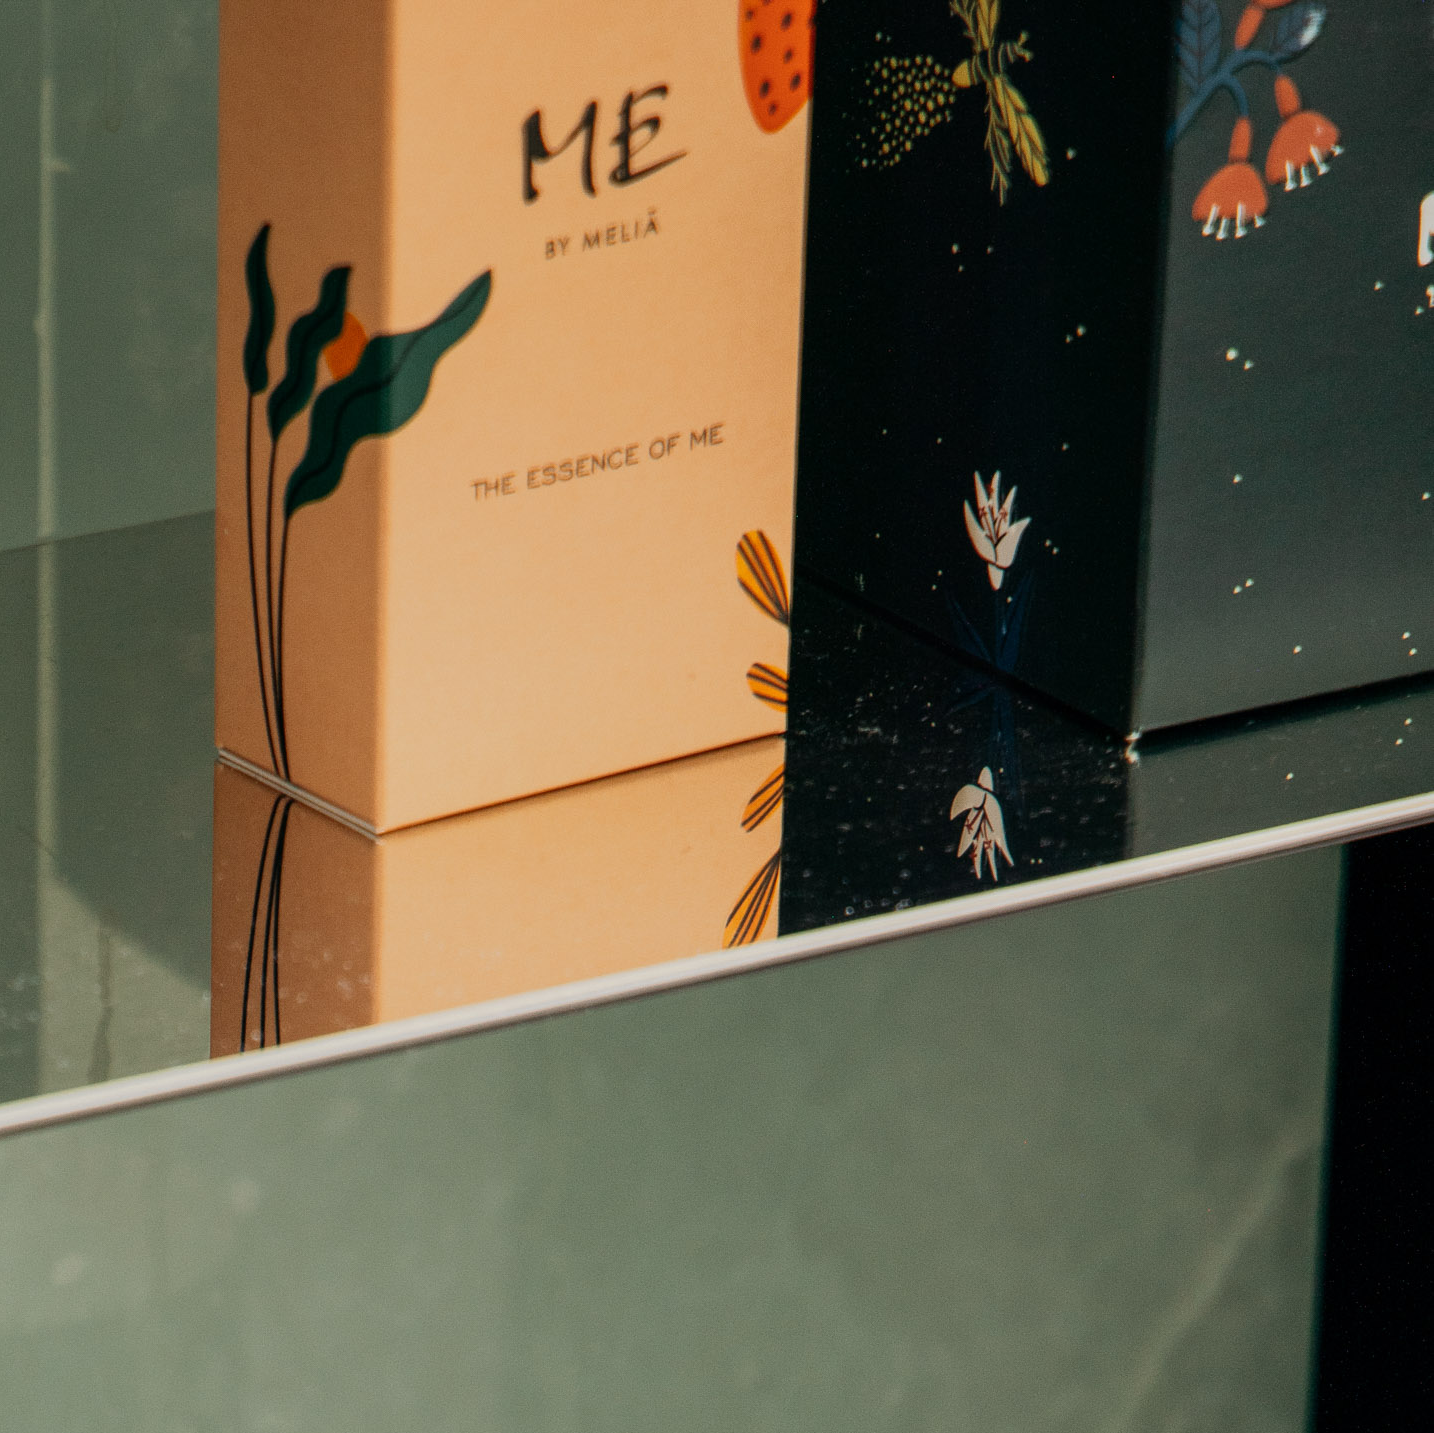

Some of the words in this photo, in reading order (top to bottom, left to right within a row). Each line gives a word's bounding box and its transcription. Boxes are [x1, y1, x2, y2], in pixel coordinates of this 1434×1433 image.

[520, 82, 687, 204] ME
[544, 236, 571, 261] BY
[471, 473, 516, 501] THE
[526, 445, 640, 490] ESSENCE
[648, 432, 682, 463] OF
[689, 423, 724, 450] ME
